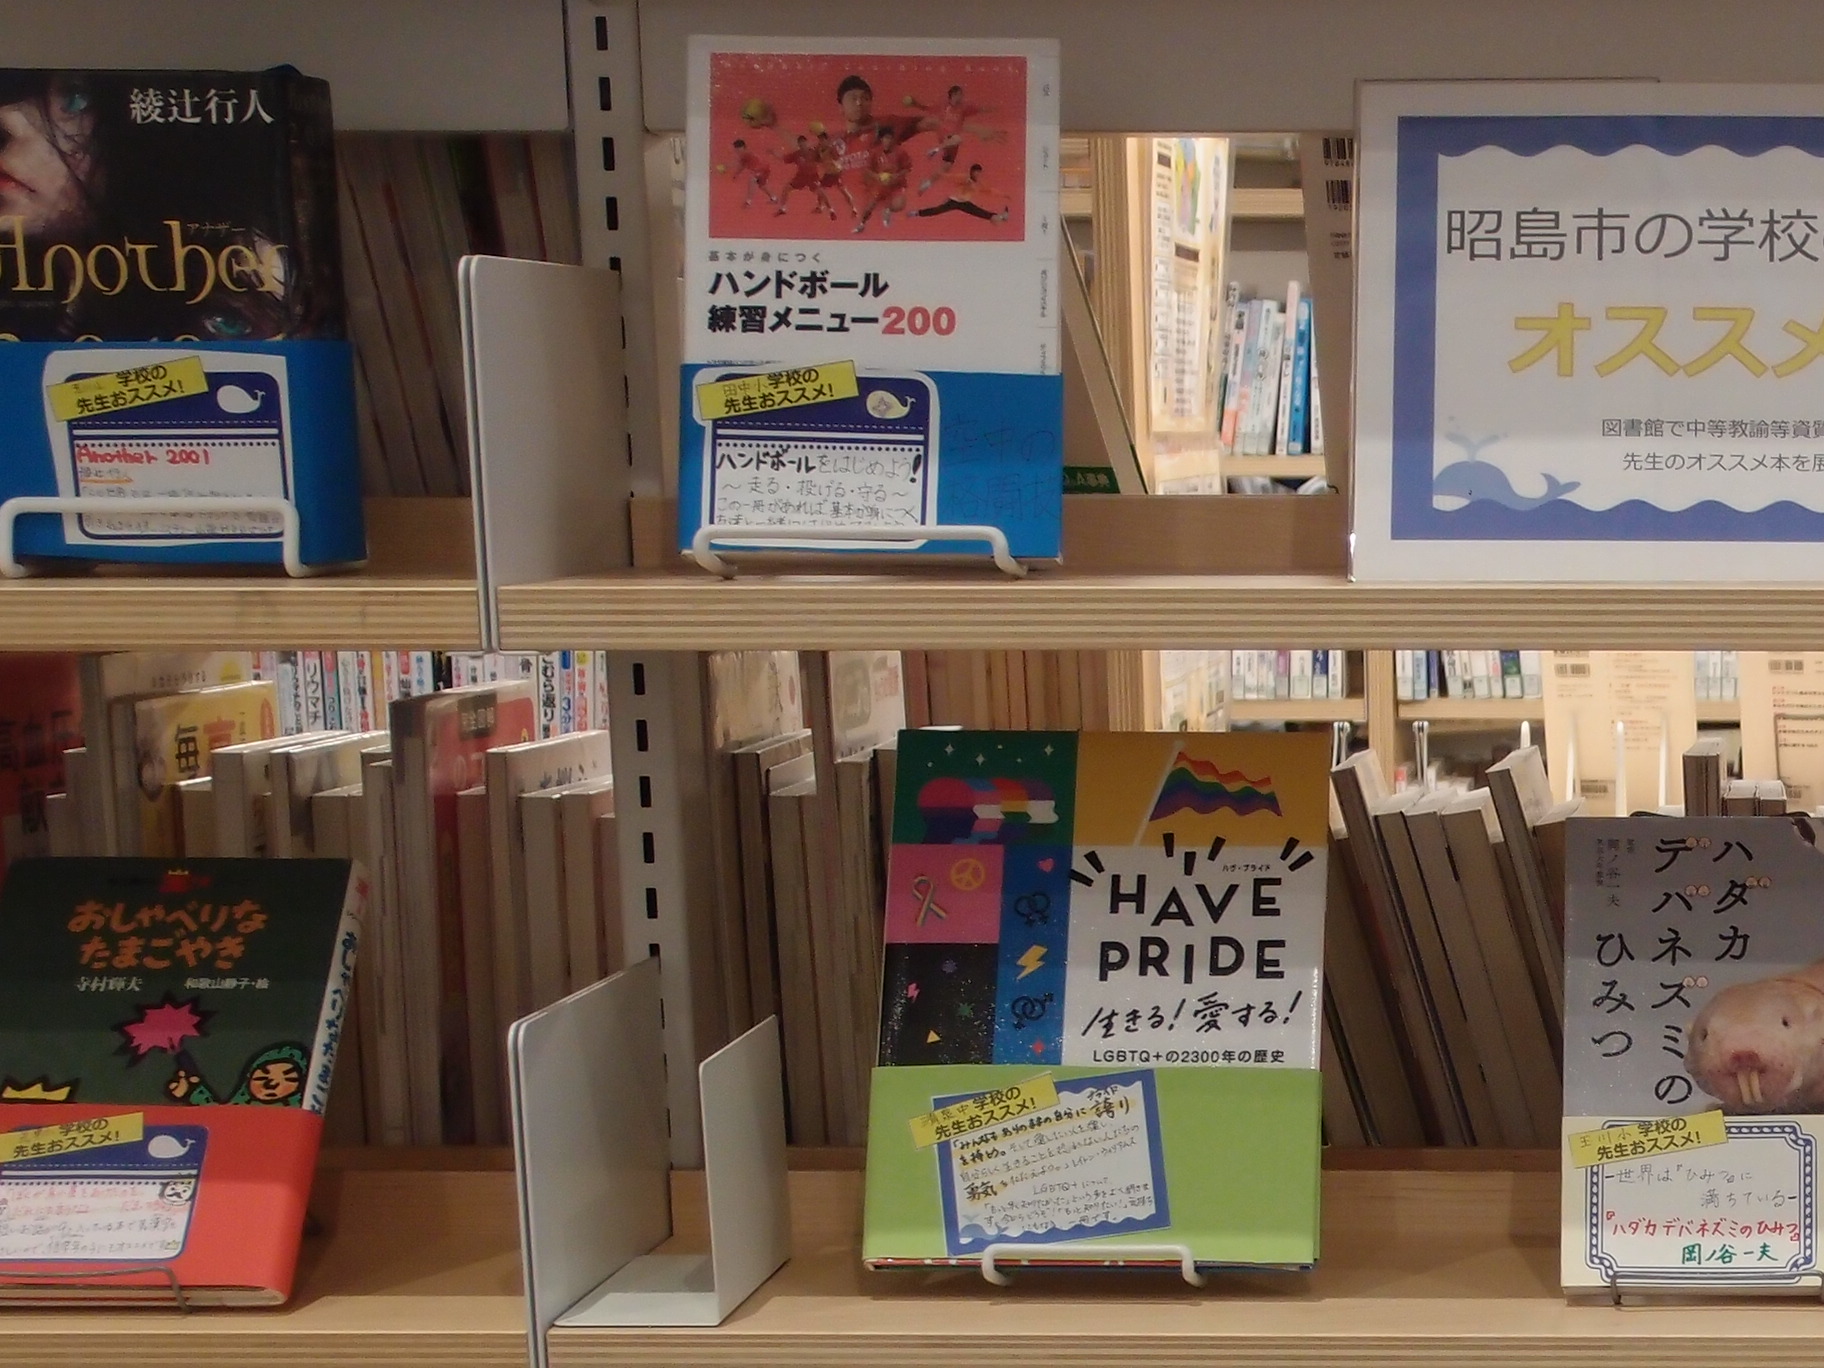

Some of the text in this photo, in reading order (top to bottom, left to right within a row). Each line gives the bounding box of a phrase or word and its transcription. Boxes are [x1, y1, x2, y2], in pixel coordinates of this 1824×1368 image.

[129, 87, 275, 126] 綾辻行人
[708, 250, 822, 263] 基本が身につく
[708, 270, 889, 299] ハンドボール
[707, 306, 957, 335] 練習メニュー200
[116, 365, 167, 387] 学校の
[767, 368, 820, 391] 学校の
[77, 380, 184, 414] 先生おススメ!
[723, 384, 834, 414] 先生おススメ!
[76, 446, 209, 464] Another 2001
[1110, 874, 1282, 927] HAVE
[1713, 840, 1772, 962] ハダカ
[68, 900, 268, 933] おしゃべりな
[80, 929, 247, 969] たまごやき
[1099, 936, 1286, 984] PRIDE
[1651, 837, 1711, 1104] デバネズミの
[1591, 933, 1635, 1058] ひみつ
[1082, 990, 1303, 1038] 生きる! 愛する!
[1092, 1049, 1286, 1064] LGBTQ+の2300年の歴史
[973, 1086, 1021, 1111] 学校の
[59, 1118, 109, 1137] 学校の
[935, 1098, 1036, 1141] 先生おススメ!
[1637, 1117, 1687, 1138] 学校の
[13, 1131, 120, 1159] 先生おススメ!
[1597, 1133, 1701, 1161] 先生おススメ!
[1606, 1211, 1800, 1241] 『ハダカデバネズミのひみつ』
[1682, 1243, 1778, 1265] 岡ノ谷一夫
